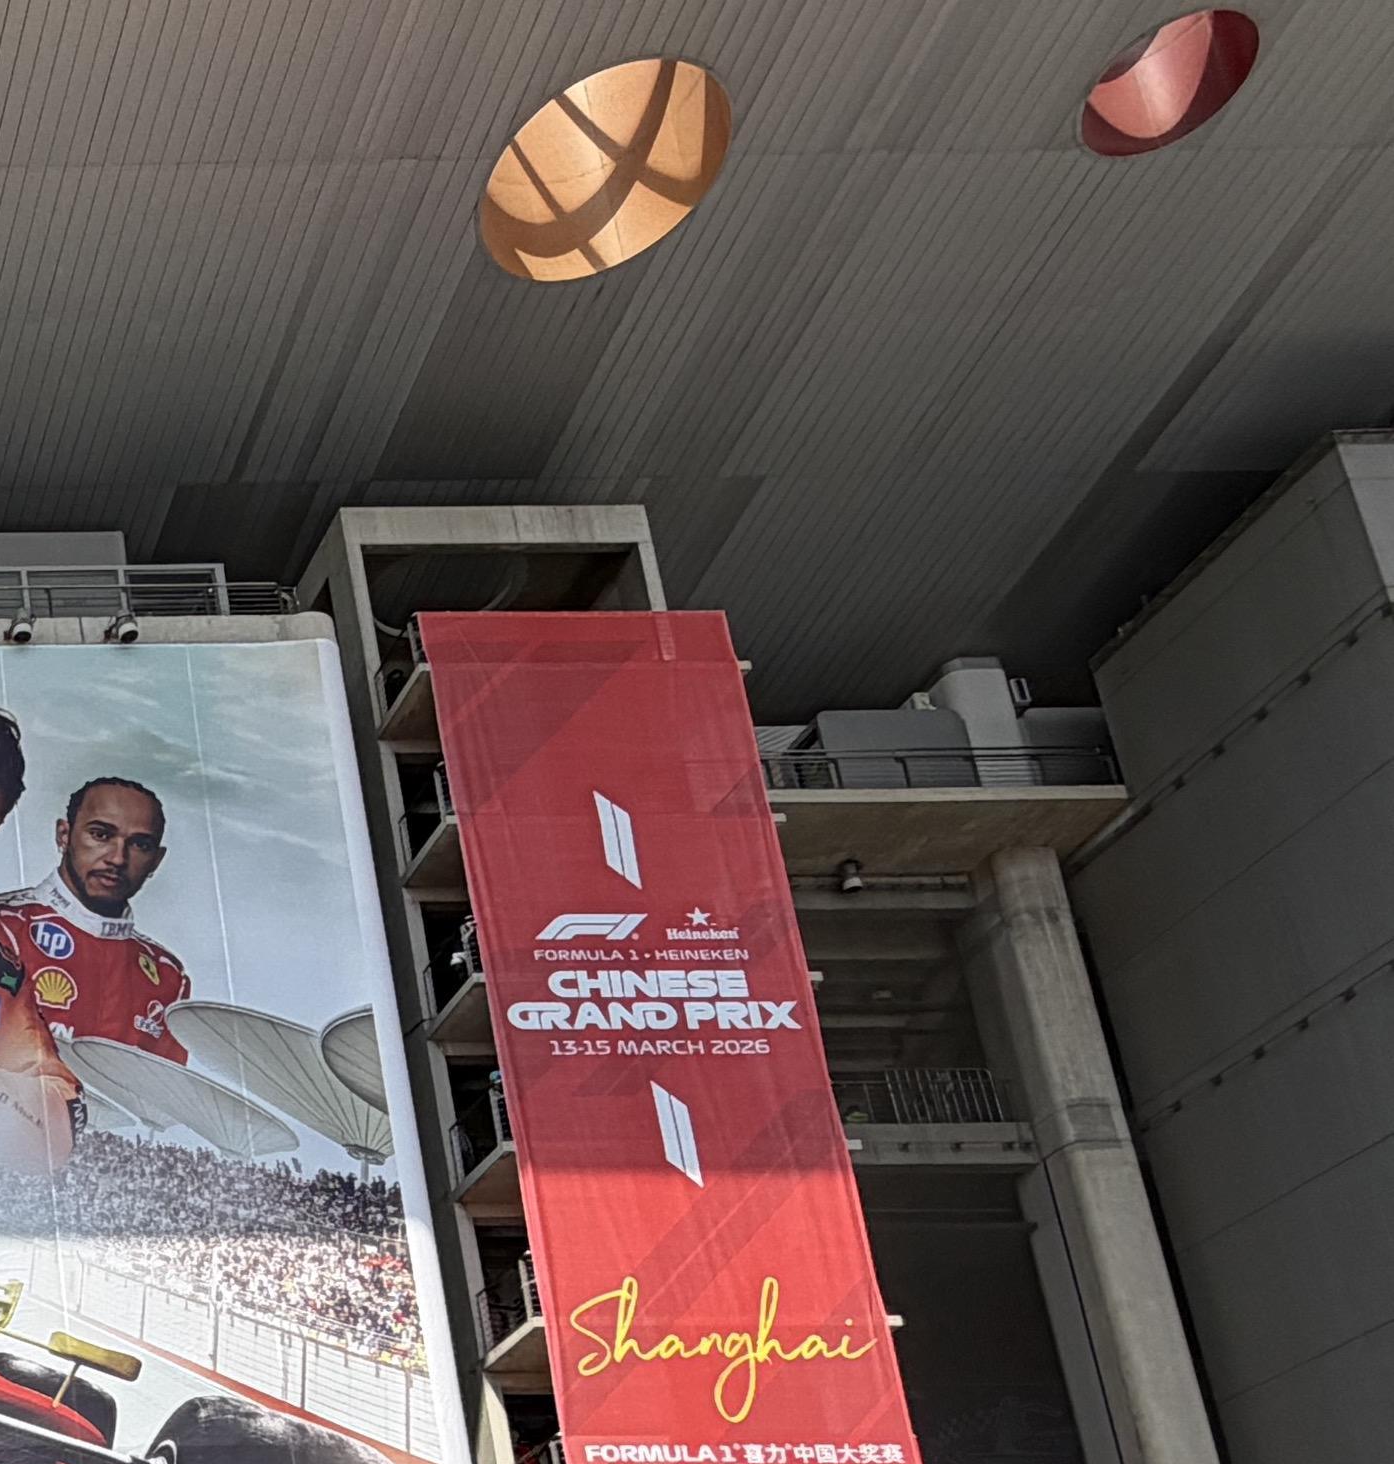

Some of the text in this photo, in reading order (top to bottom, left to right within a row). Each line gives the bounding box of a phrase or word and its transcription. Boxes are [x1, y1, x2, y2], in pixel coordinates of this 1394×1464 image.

[36, 923, 66, 957] hp
[665, 927, 739, 941] Heineken
[533, 949, 749, 961] FORMULA 1 HEINEKEN
[547, 970, 749, 998] CHINESE
[507, 1000, 802, 1030] GRAND PRIX
[550, 1039, 770, 1056] 13-15 MARCH 2026
[570, 1276, 878, 1423] Shanghai
[585, 1445, 717, 1463] FORMULA
